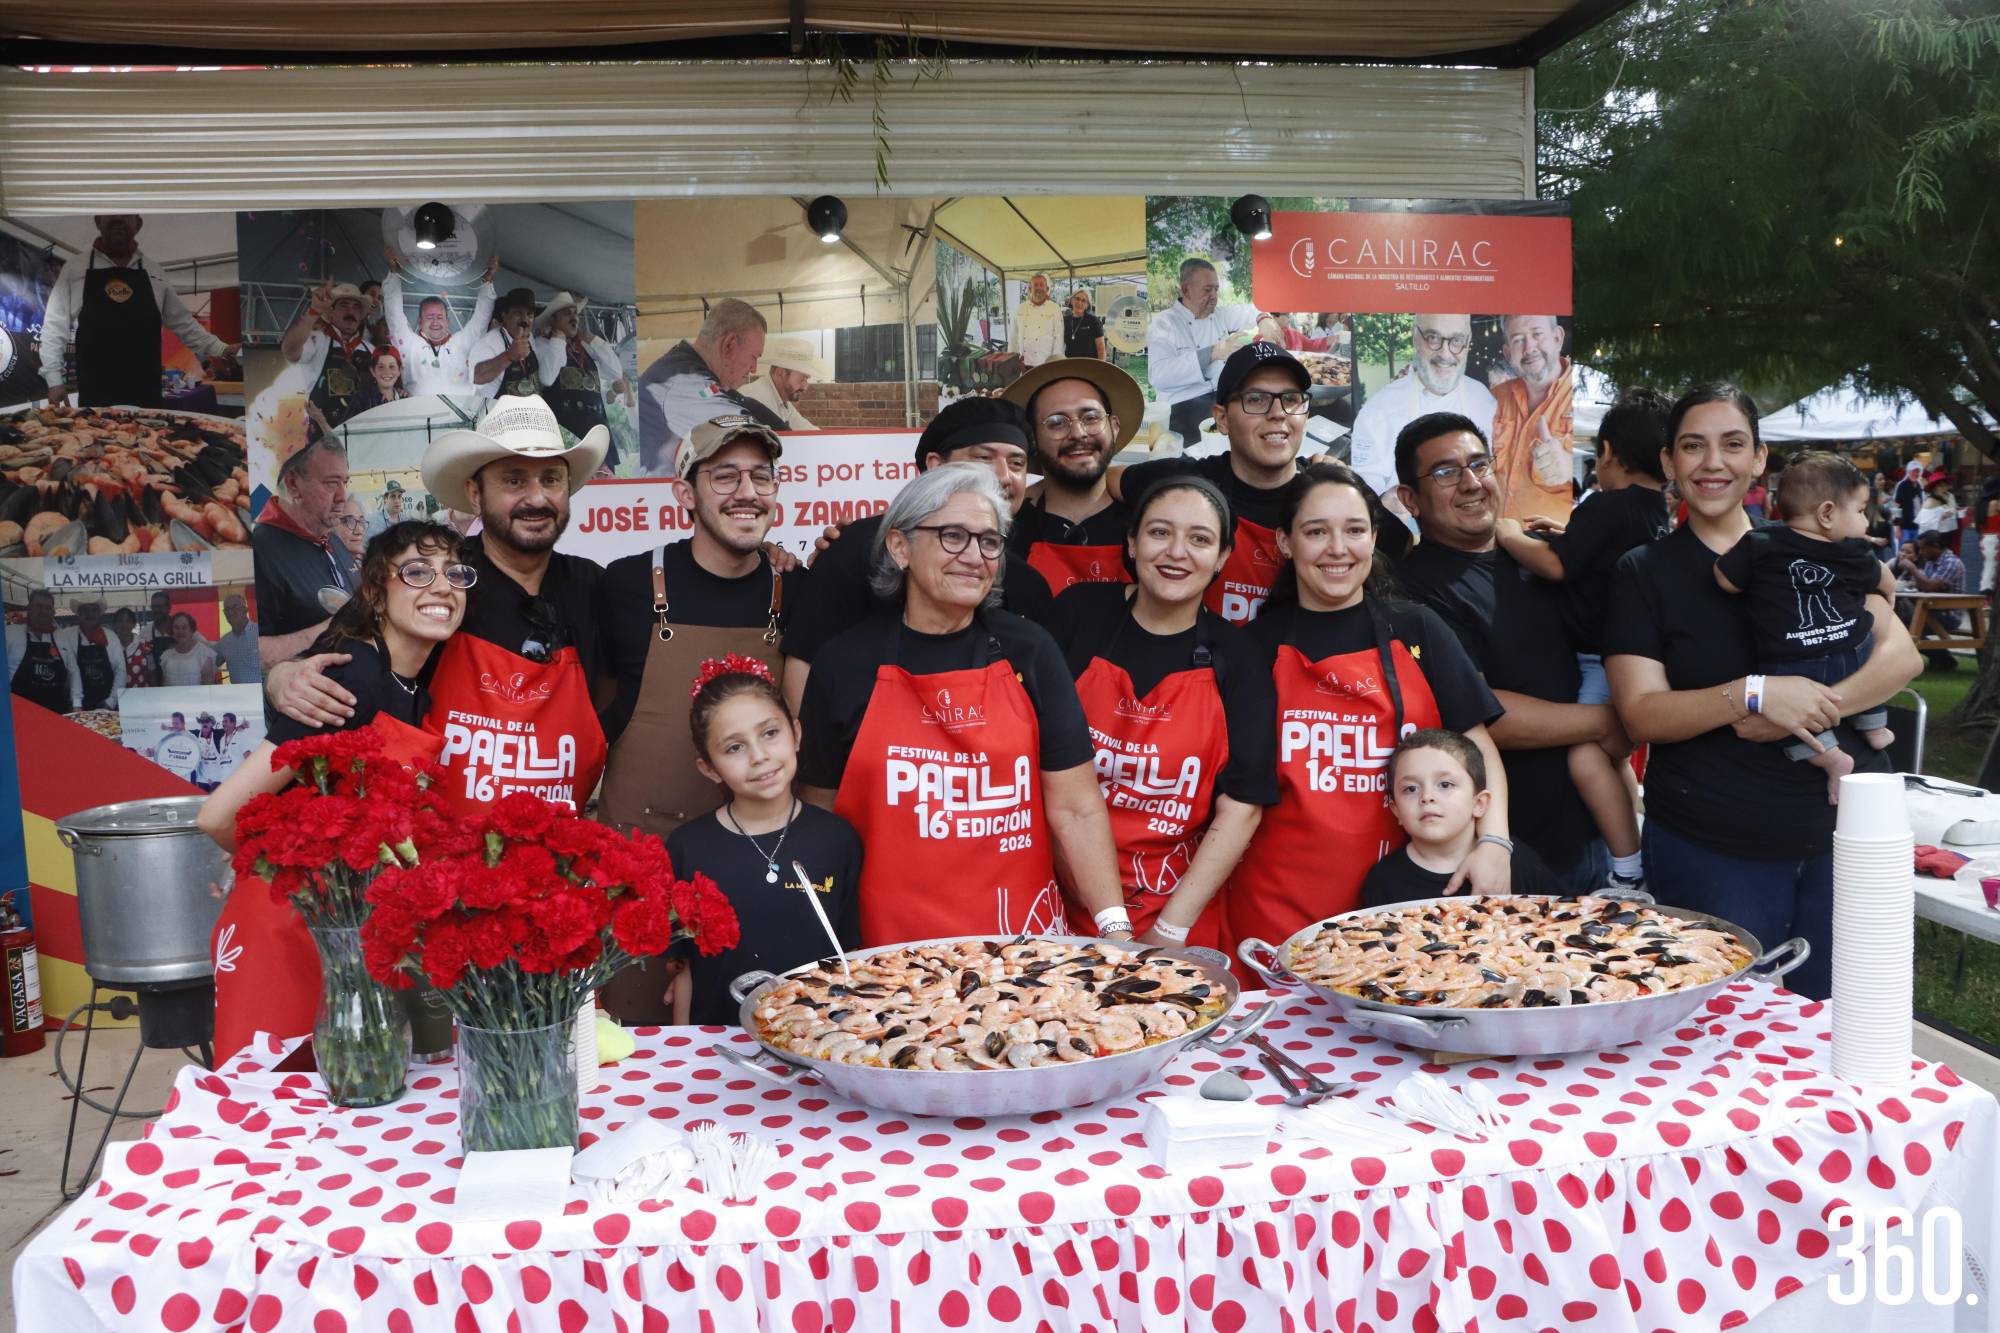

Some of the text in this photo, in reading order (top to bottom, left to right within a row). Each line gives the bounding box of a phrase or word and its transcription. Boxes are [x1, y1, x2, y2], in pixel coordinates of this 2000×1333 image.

[1328, 238, 1492, 267] CANIRAC
[1395, 282, 1431, 291] SALTILLO
[817, 463, 865, 487] por
[872, 459, 918, 481] tan
[578, 498, 649, 533] JOSÉ
[53, 571, 207, 586] LA MARIPOSA GRILL
[1786, 628, 1826, 640] Augusto
[448, 710, 536, 733] FESTIVAL DE LA
[1283, 709, 1377, 723] FESTIVAL DE LA
[439, 722, 577, 780] PAELLA
[887, 745, 989, 764] FESTIVAL DE LA
[1125, 742, 1141, 754] DE
[1143, 743, 1159, 754] LA
[886, 755, 1032, 812] PAELLA
[1091, 748, 1201, 799] AELLA
[1344, 773, 1388, 793] EDIC
[1112, 795, 1192, 821] EDICIÓN
[956, 805, 1032, 838] EDICIÓN
[1147, 817, 1185, 836] 2026
[999, 833, 1032, 853] 2026
[12, 972, 27, 1026] VAGASA
